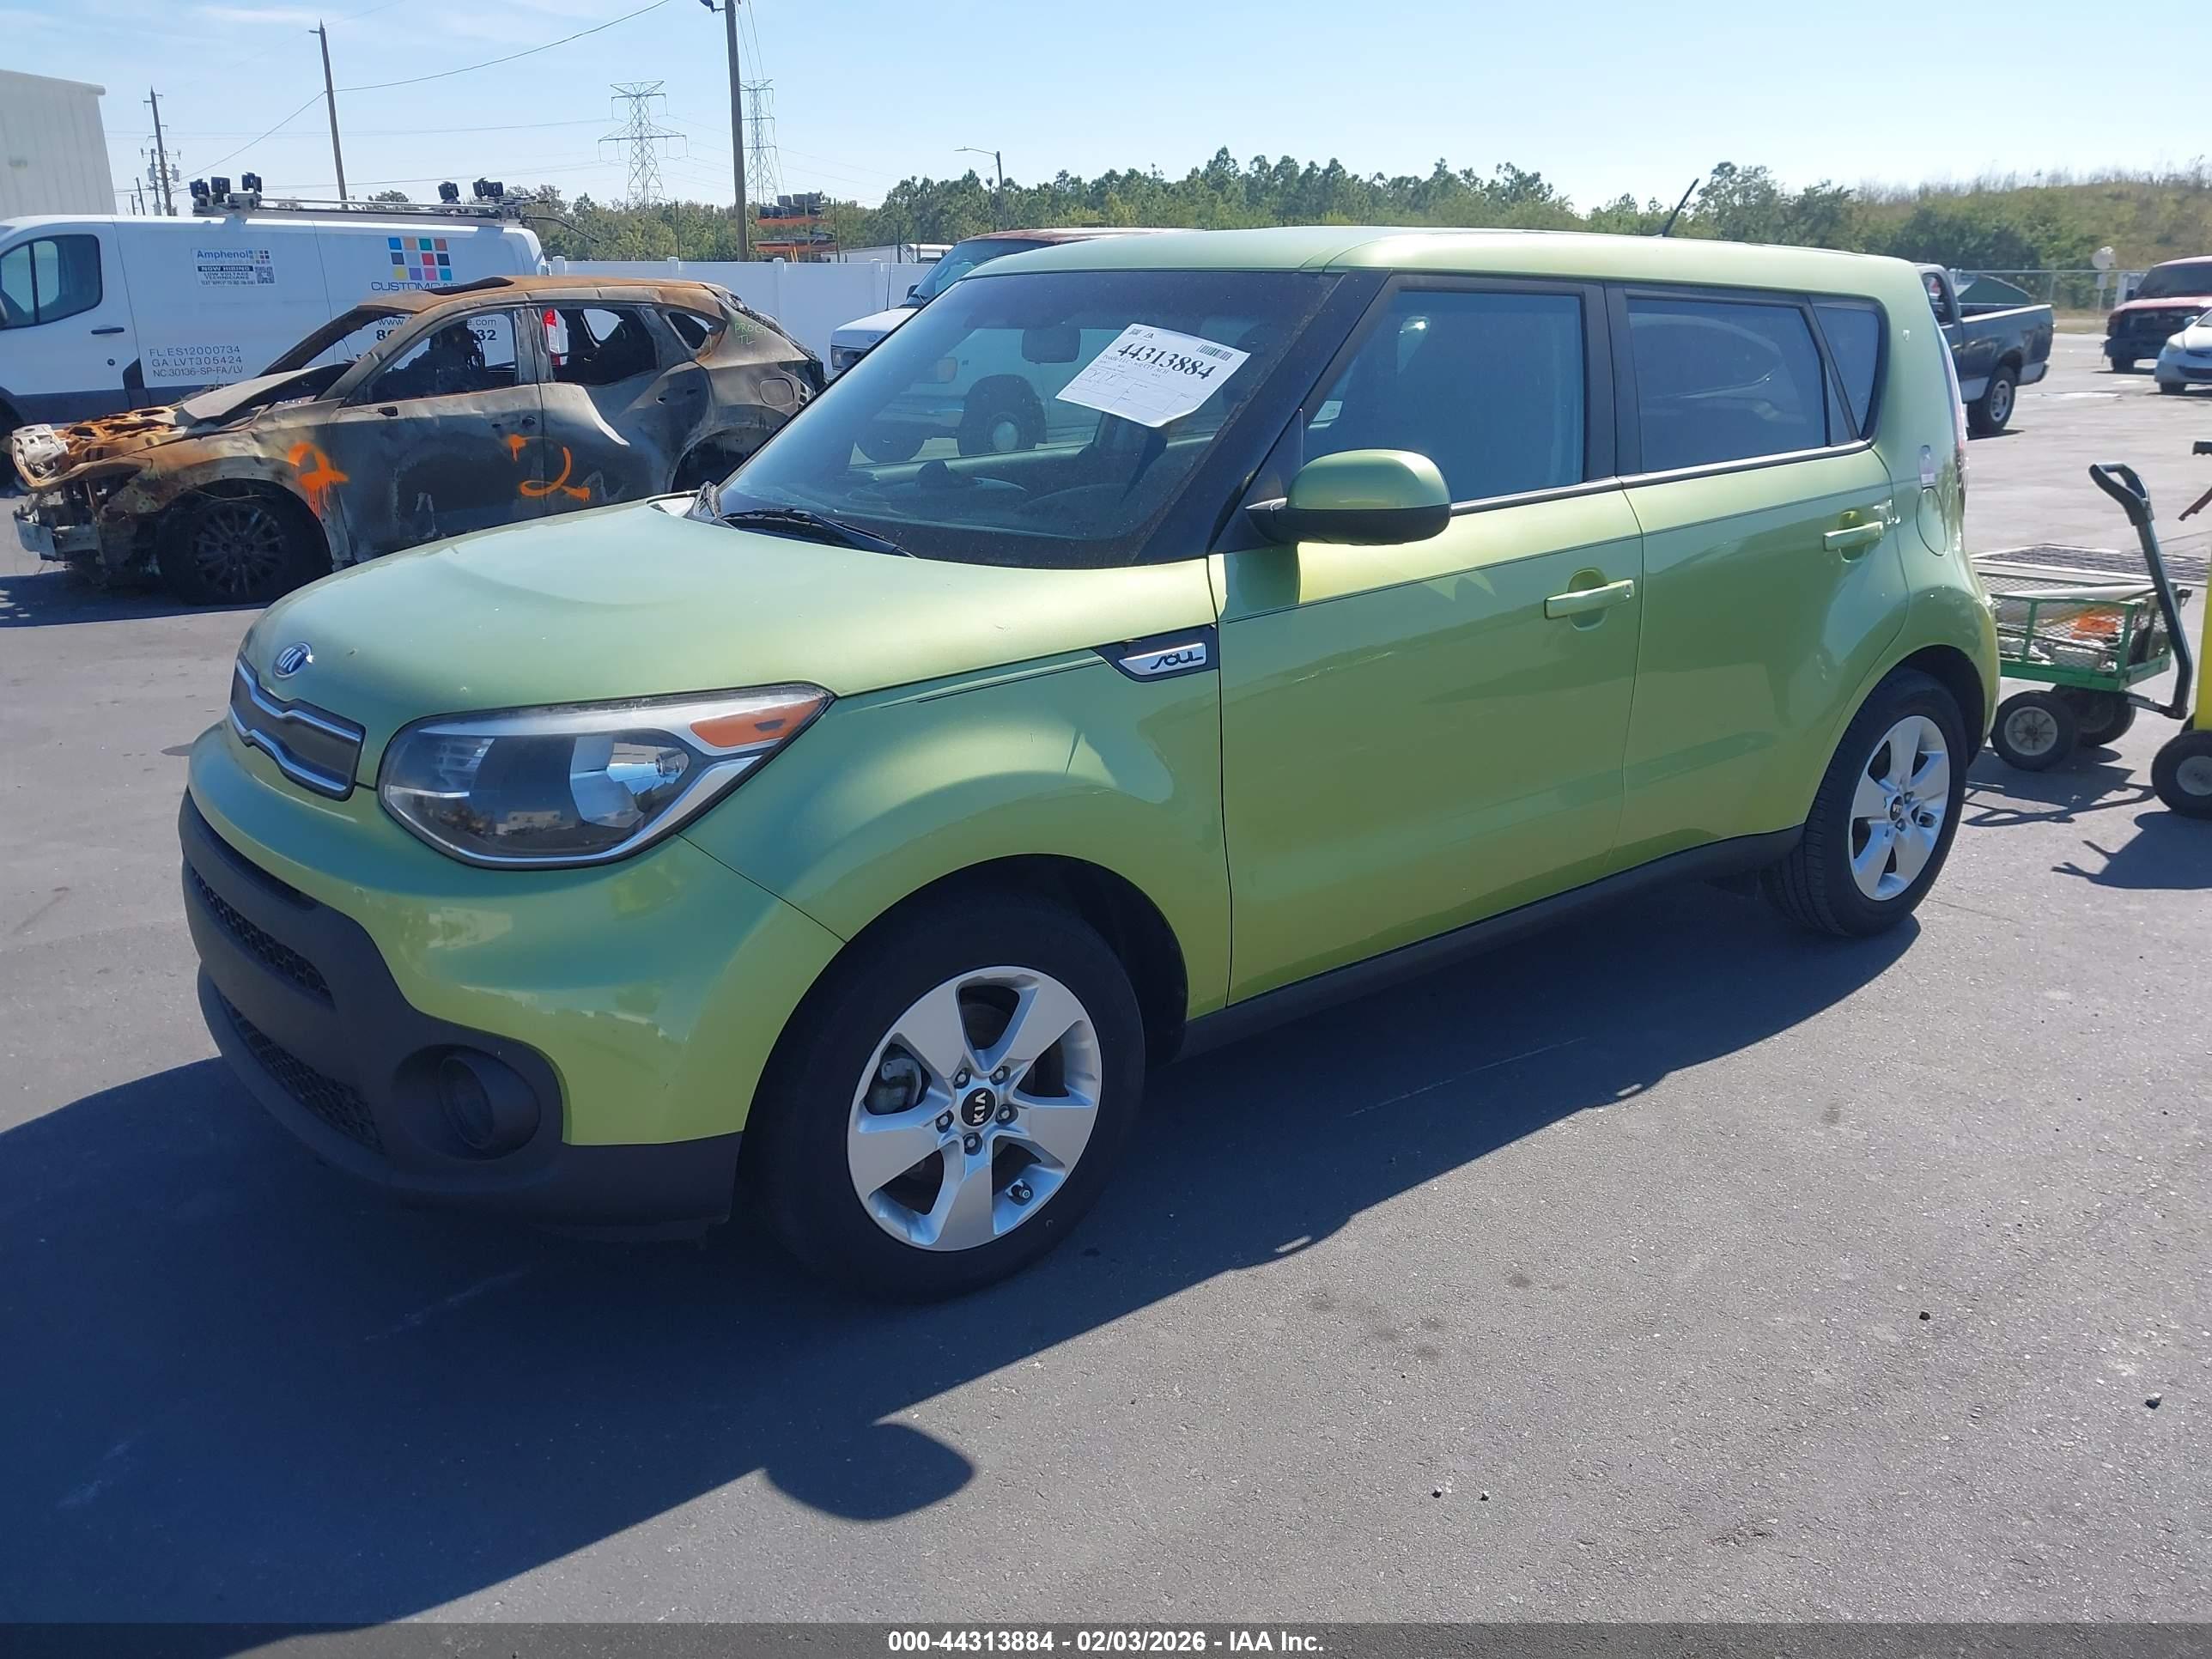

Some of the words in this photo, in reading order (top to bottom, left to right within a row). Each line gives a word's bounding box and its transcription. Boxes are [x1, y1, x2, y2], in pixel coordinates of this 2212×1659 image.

[198, 249, 249, 259] Amphenol
[1117, 343, 1217, 380] 44313884
[972, 1091, 987, 1124] KIA
